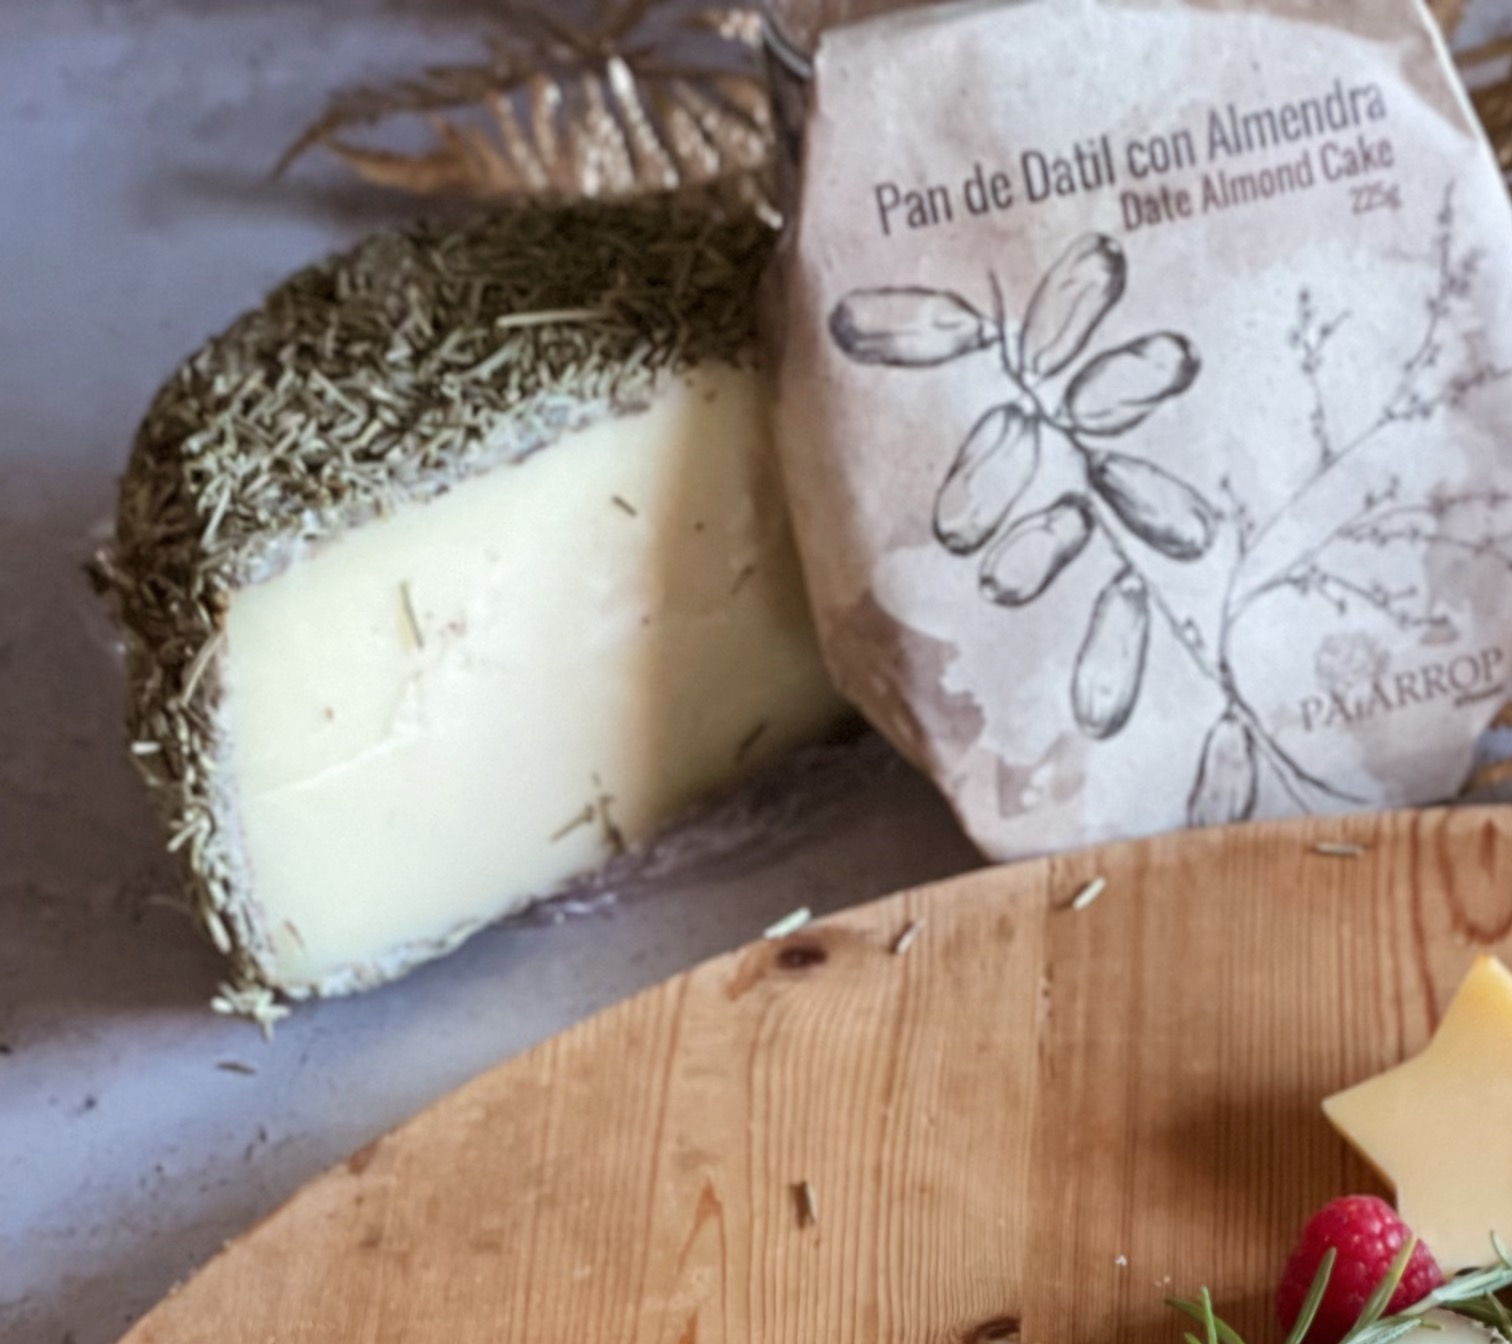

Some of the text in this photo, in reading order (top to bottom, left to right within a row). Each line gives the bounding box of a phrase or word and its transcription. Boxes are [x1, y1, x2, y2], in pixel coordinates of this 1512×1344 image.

[875, 77, 1387, 236] Pan de Datil con Almendra
[1119, 135, 1395, 232] Date Almond Cake
